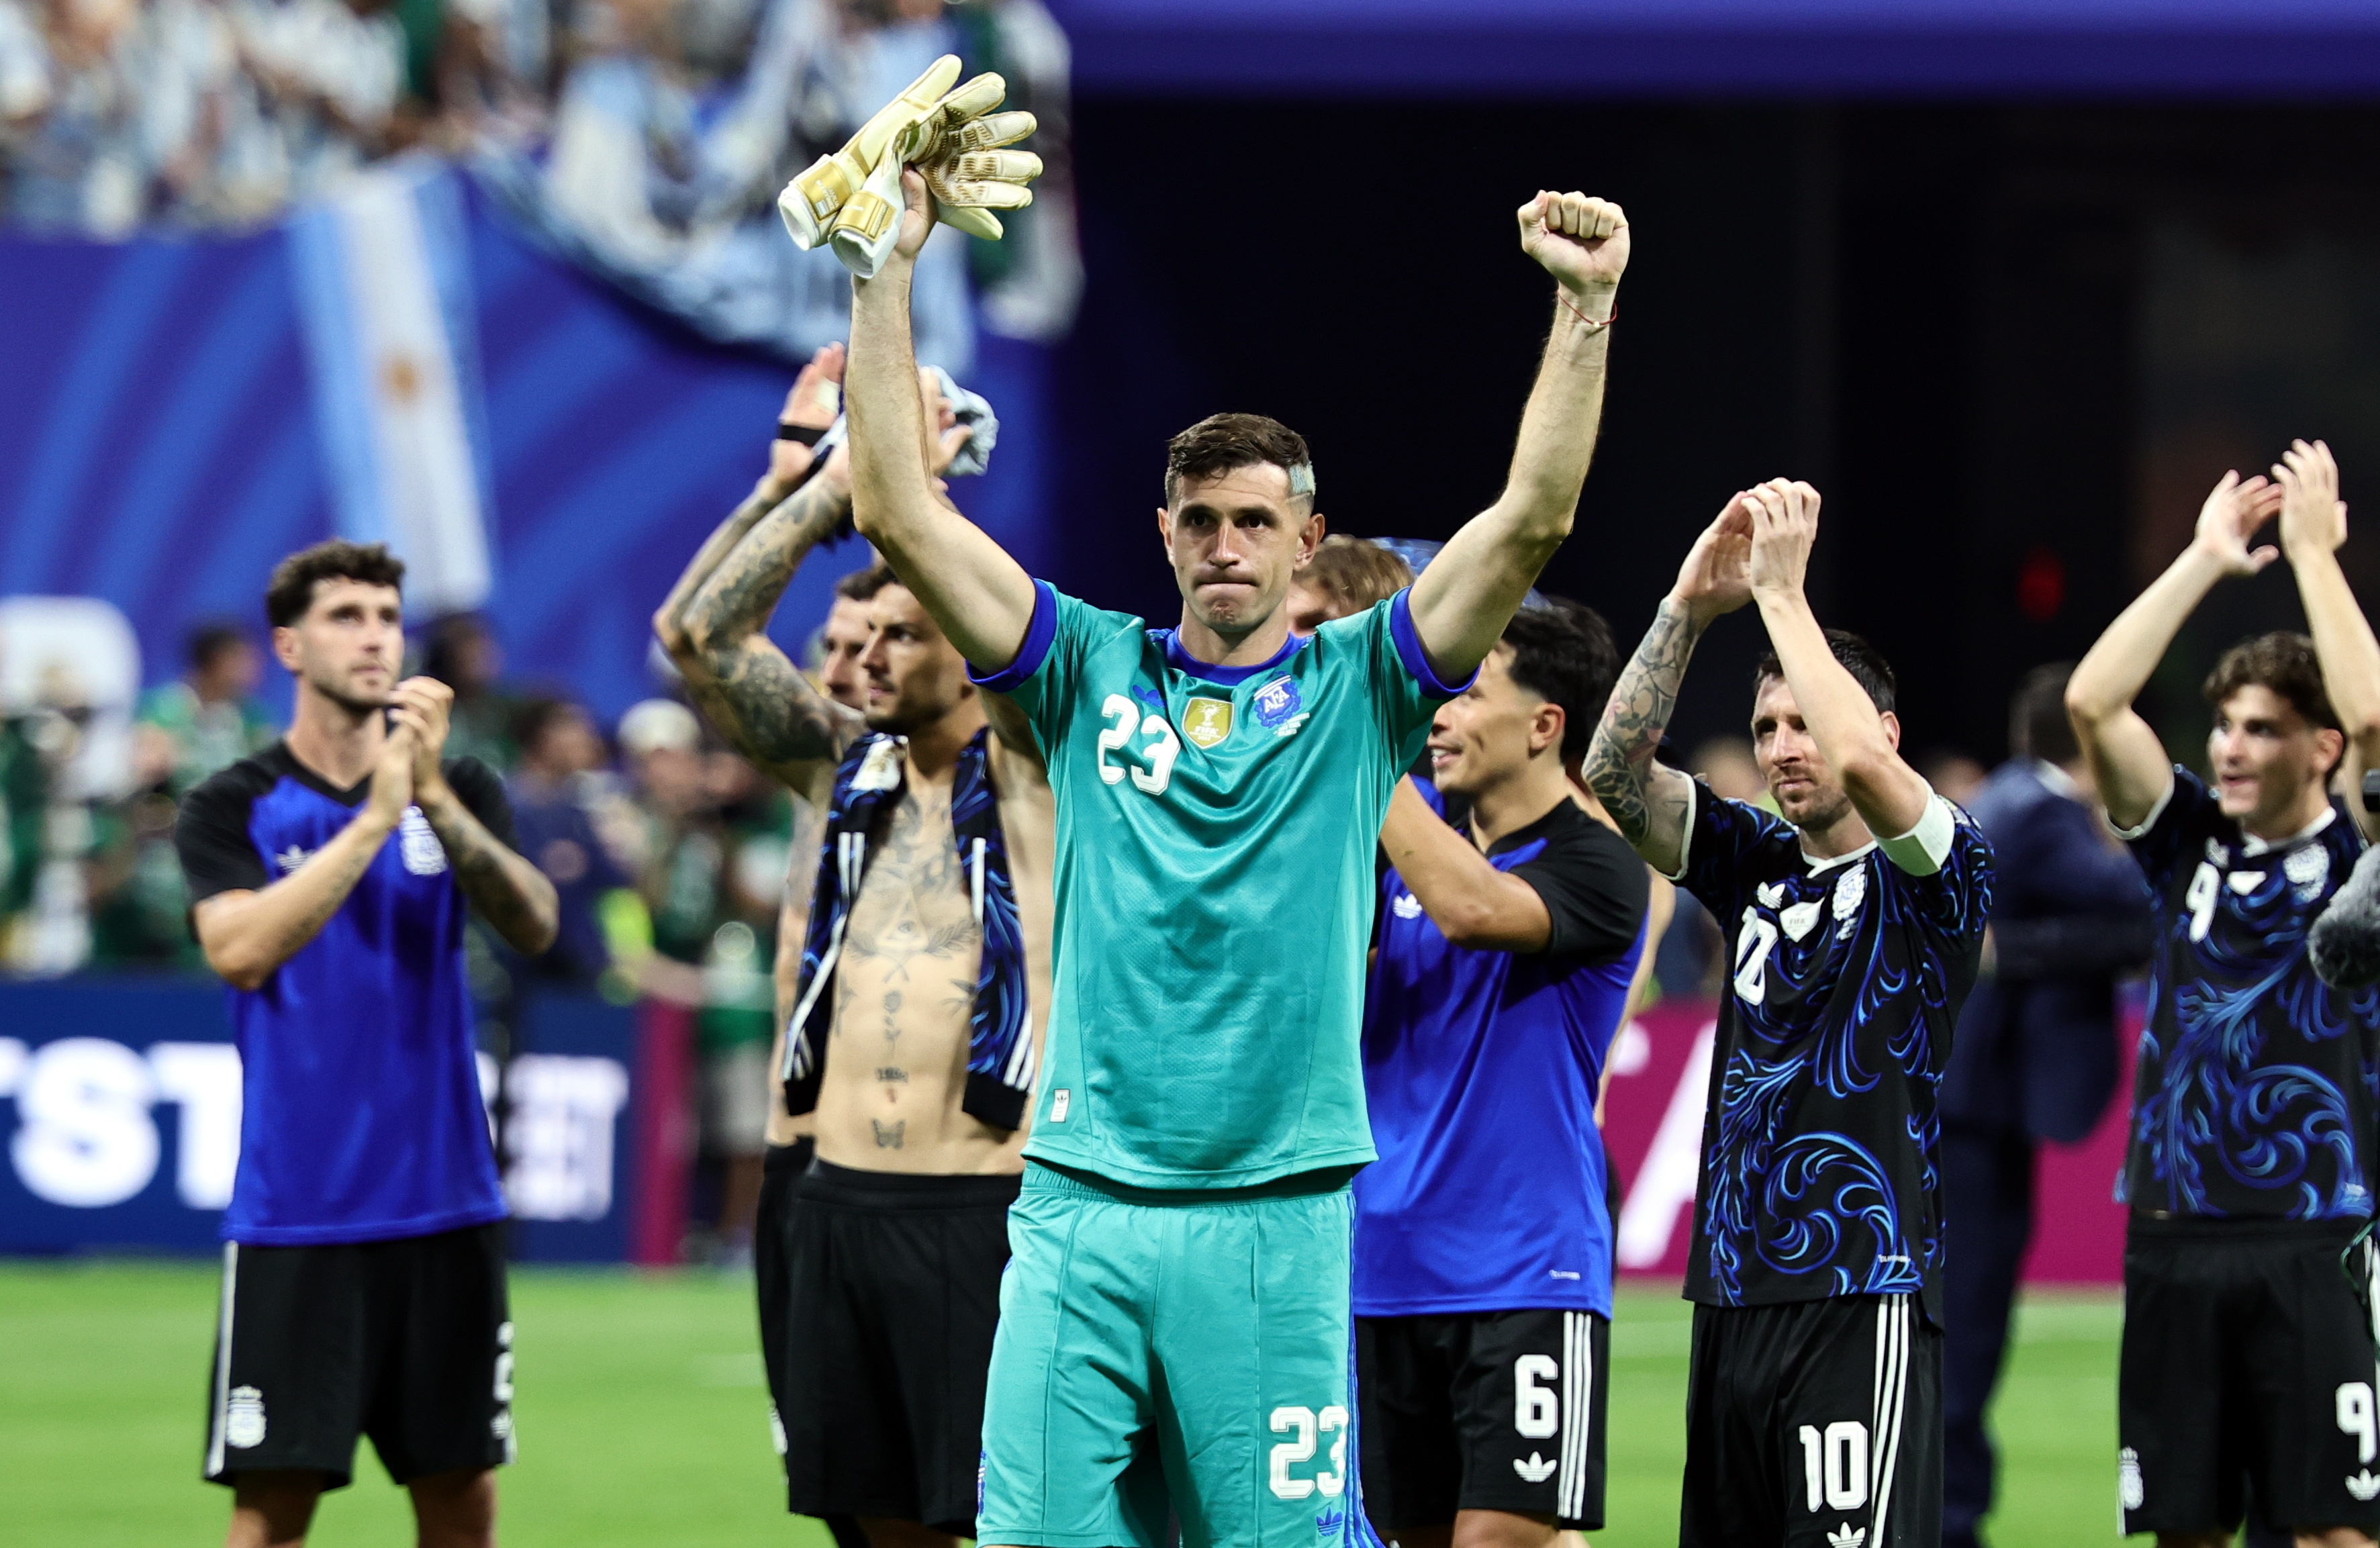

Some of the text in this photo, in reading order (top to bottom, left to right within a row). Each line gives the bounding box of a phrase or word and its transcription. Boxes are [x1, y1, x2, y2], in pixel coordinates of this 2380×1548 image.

[1194, 725, 1217, 736] FIFA
[1263, 685, 1290, 714] AFA
[1098, 693, 1181, 795] 23
[1789, 917, 1806, 926] FIFA
[2185, 861, 2222, 944] 9
[1733, 905, 1779, 1006] 10
[1515, 1353, 1558, 1439] 6
[2335, 1381, 2377, 1465] 9
[1268, 1406, 1349, 1500] 23
[1798, 1420, 1868, 1513] 10
